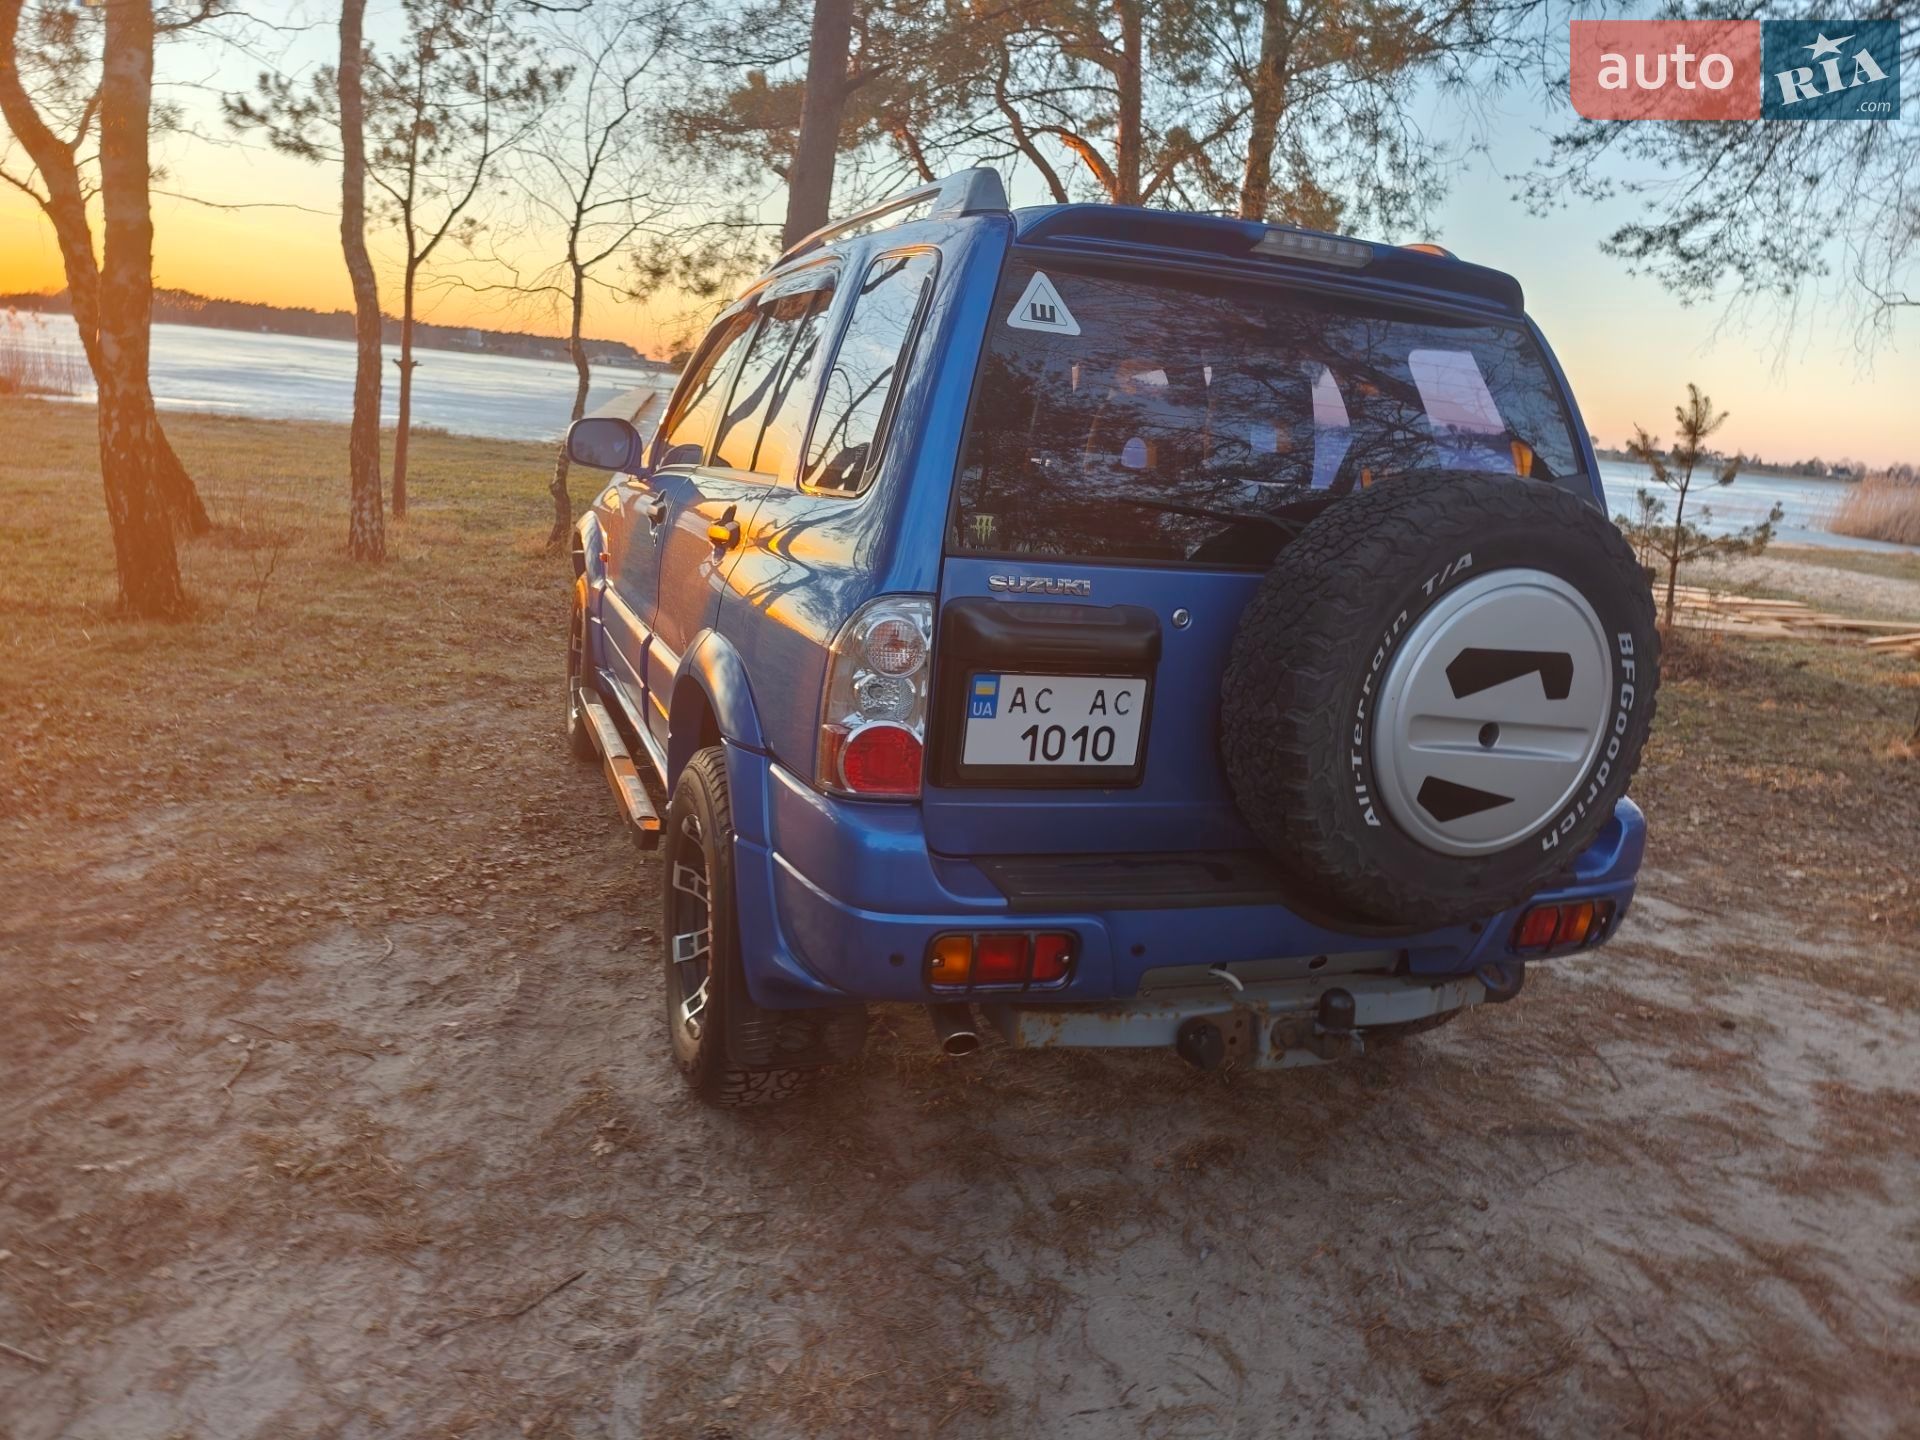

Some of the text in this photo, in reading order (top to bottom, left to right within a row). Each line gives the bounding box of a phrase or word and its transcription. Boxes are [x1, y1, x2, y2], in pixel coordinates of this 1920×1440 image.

[988, 575, 1091, 596] SUZUKI
[1008, 687, 1132, 715] AC AC
[1351, 552, 1473, 827] All-Terrain T/A
[972, 702, 993, 716] UA
[1020, 724, 1116, 762] 1010
[1541, 632, 1636, 852] BFGoodrich
